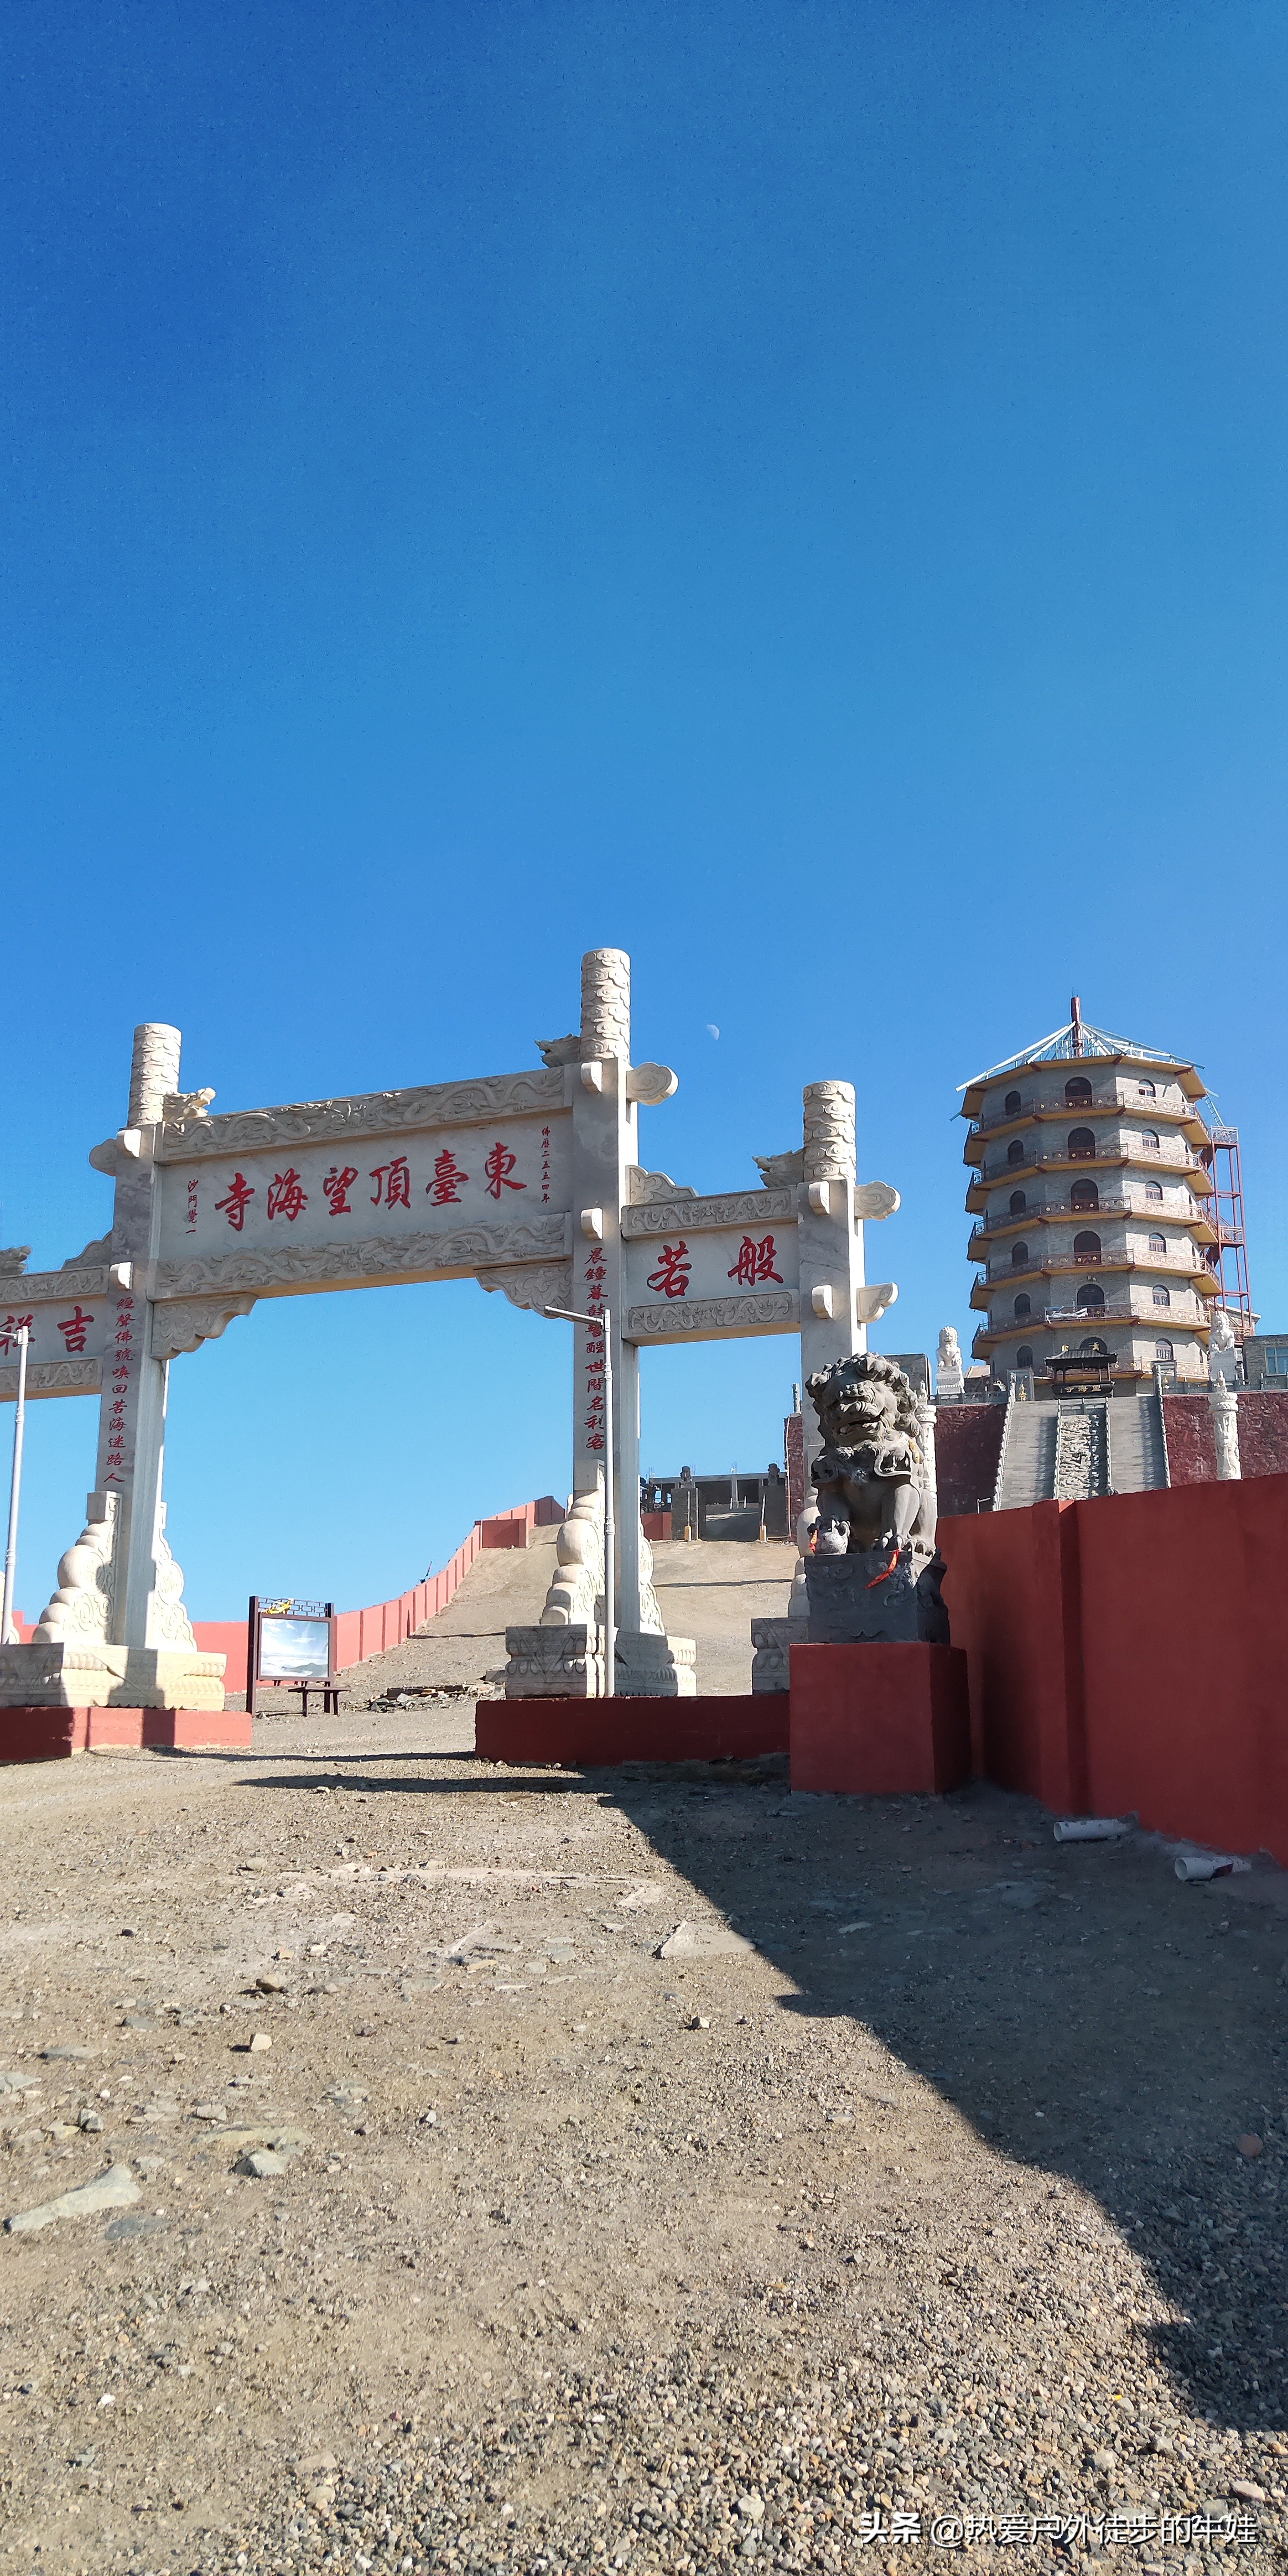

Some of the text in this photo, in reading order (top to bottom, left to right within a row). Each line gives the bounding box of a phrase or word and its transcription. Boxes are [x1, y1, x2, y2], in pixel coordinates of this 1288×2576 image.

[215, 1142, 527, 1232] 東臺頂望海寺
[647, 1234, 784, 1298] 般若
